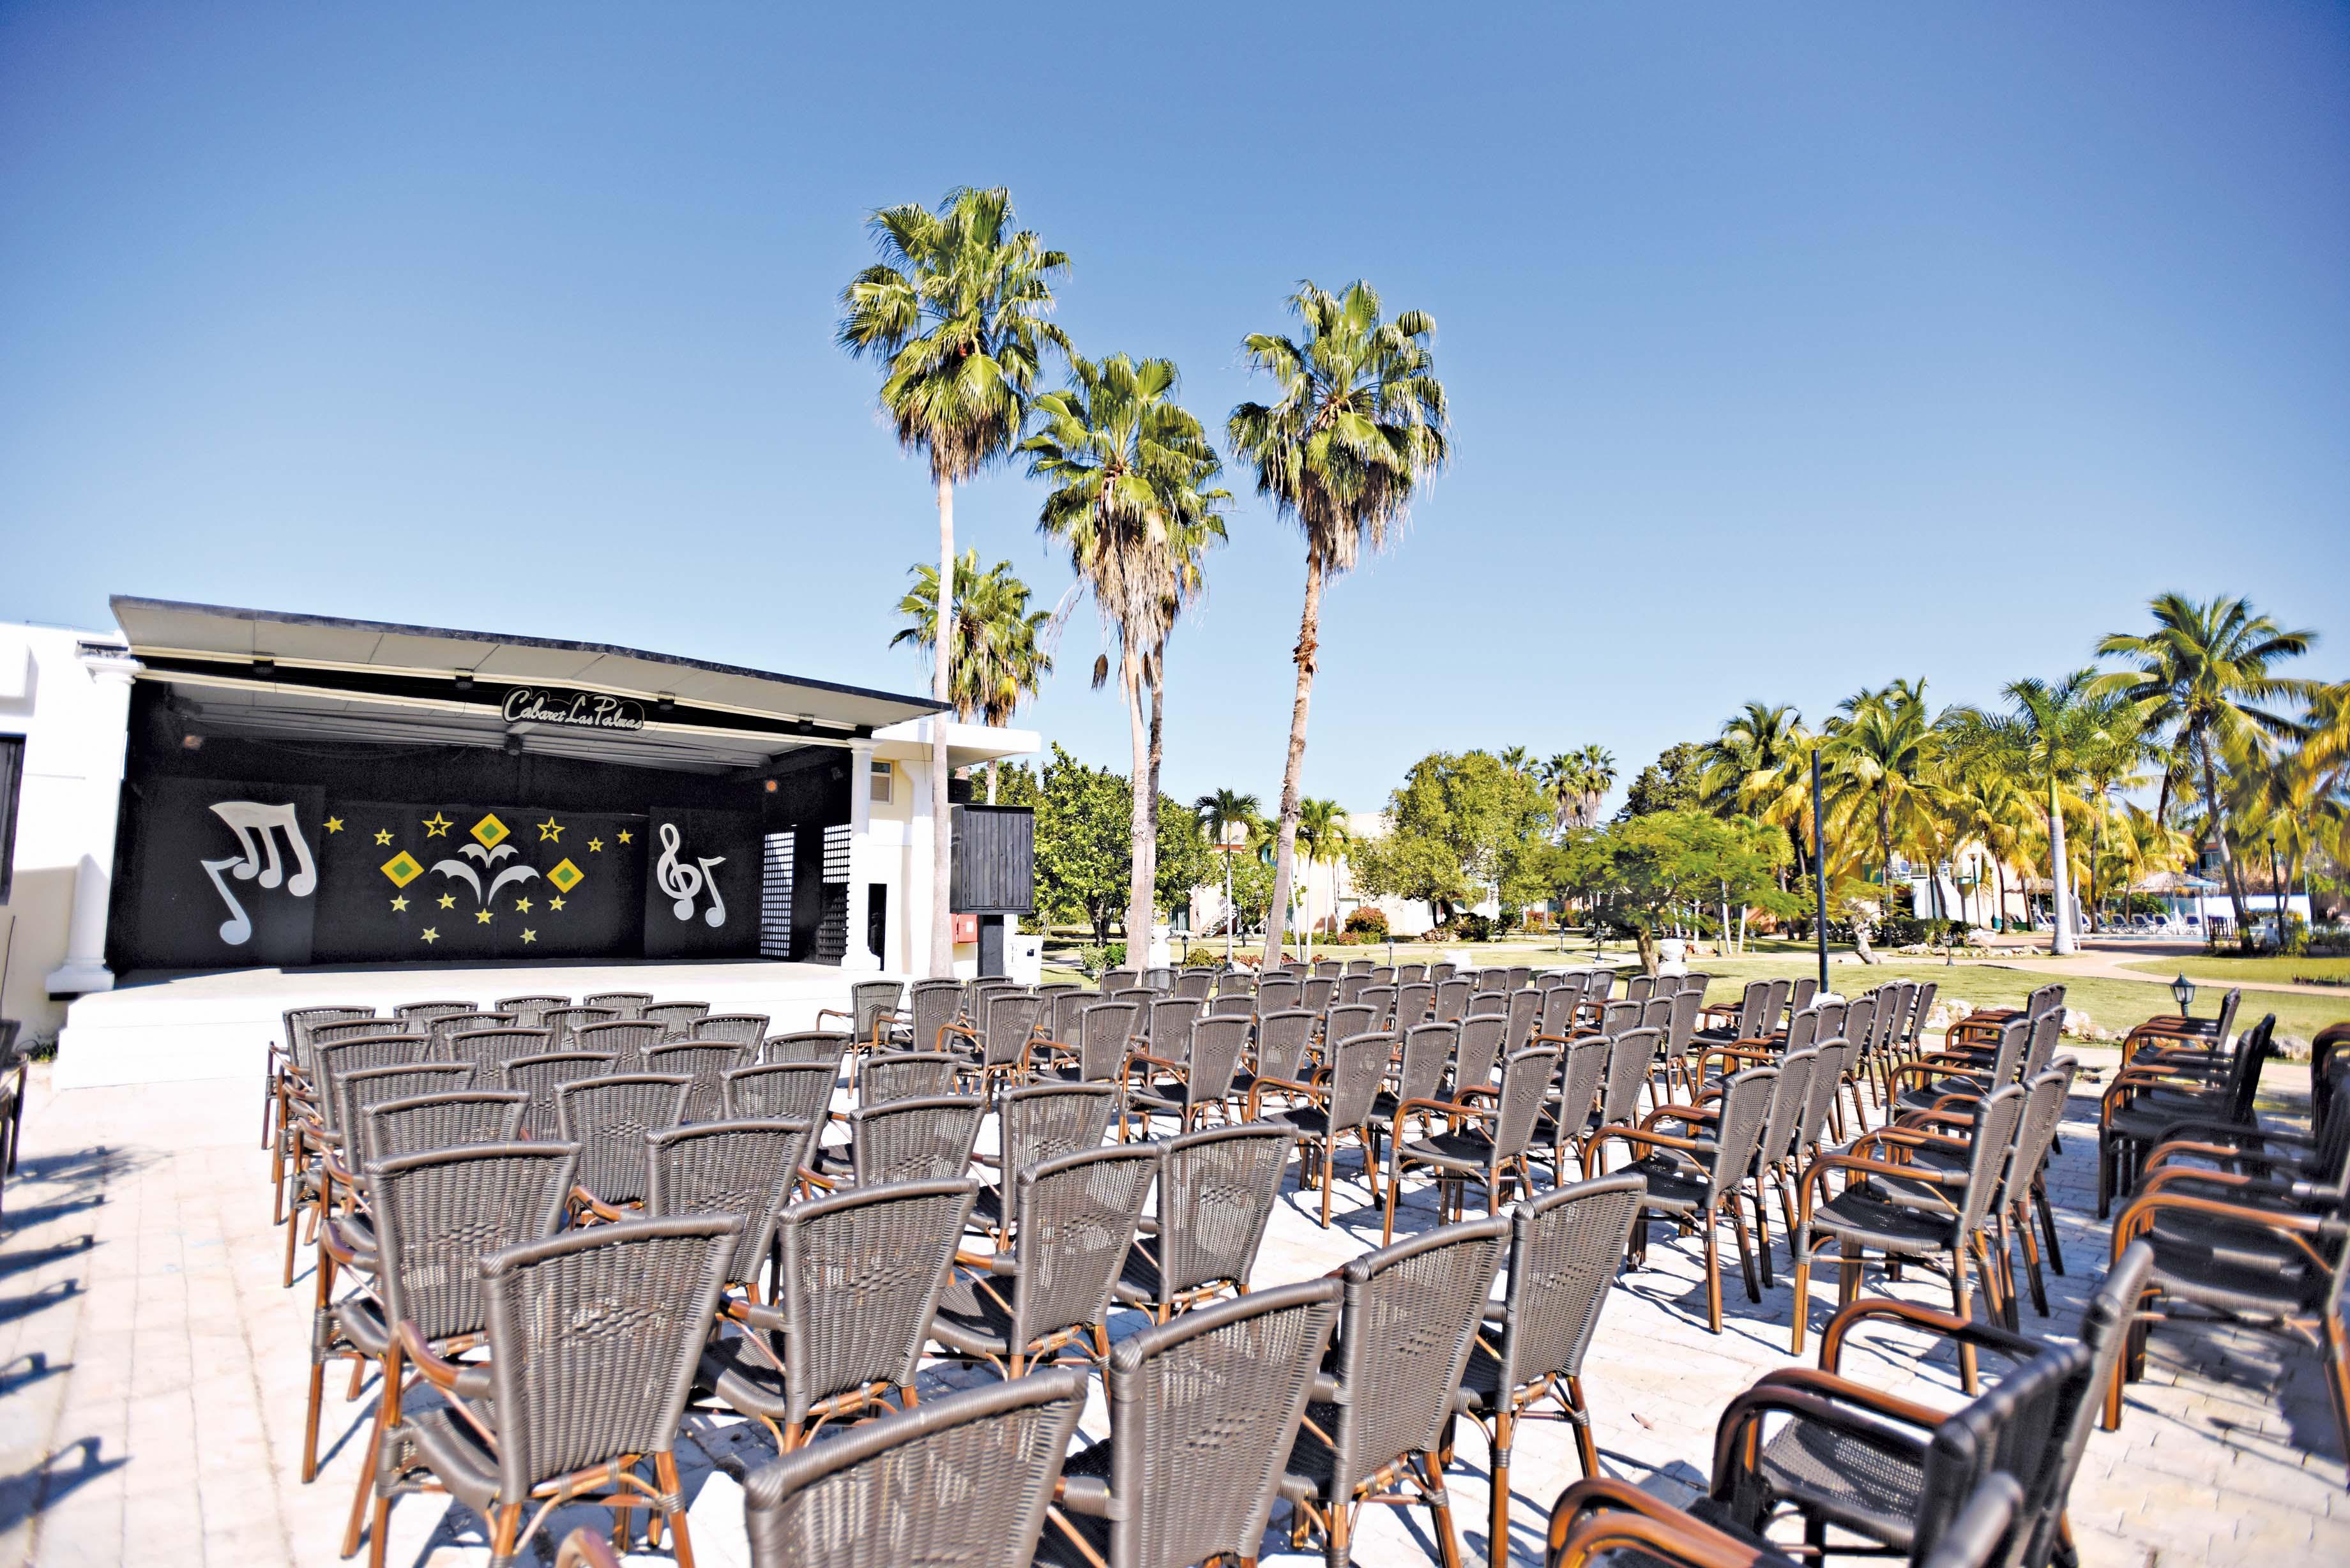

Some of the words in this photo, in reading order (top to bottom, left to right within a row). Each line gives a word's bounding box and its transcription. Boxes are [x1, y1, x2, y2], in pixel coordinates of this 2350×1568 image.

[504, 690, 566, 721] Cabaret
[565, 696, 594, 725] Las
[593, 696, 642, 729] Palmas
